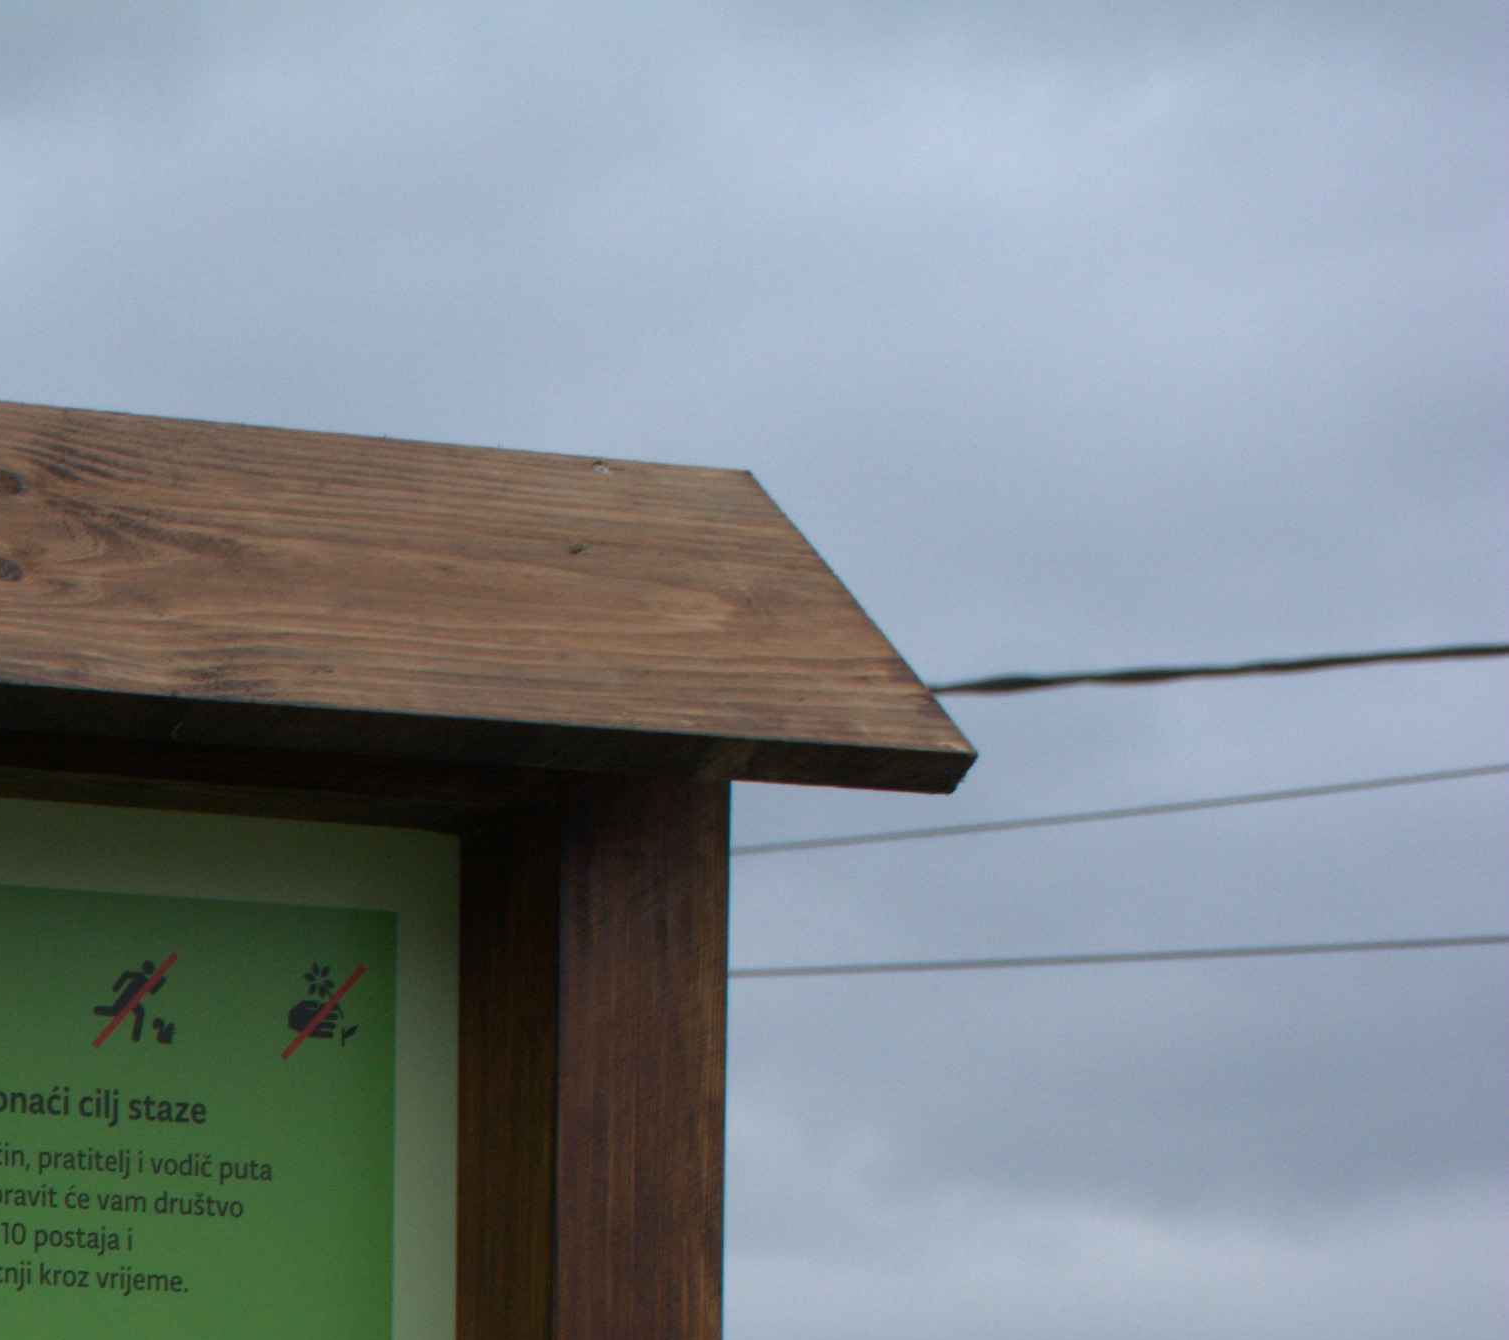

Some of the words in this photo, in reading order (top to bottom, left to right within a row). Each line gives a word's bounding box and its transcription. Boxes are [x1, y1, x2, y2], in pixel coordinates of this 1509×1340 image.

[77, 1087, 119, 1127] cilj
[128, 1094, 207, 1125] staze
[37, 1146, 131, 1180] pratitelj
[137, 1149, 144, 1173] i
[150, 1152, 213, 1179] vodič
[218, 1159, 273, 1185] puta
[63, 1184, 91, 1211] će
[96, 1192, 147, 1213] vam
[153, 1189, 245, 1219] društvo
[0, 1220, 27, 1246] 10
[33, 1225, 121, 1257] postaja
[126, 1226, 133, 1251] i
[38, 1261, 90, 1288] kroz
[95, 1264, 189, 1297] vrijeme.
